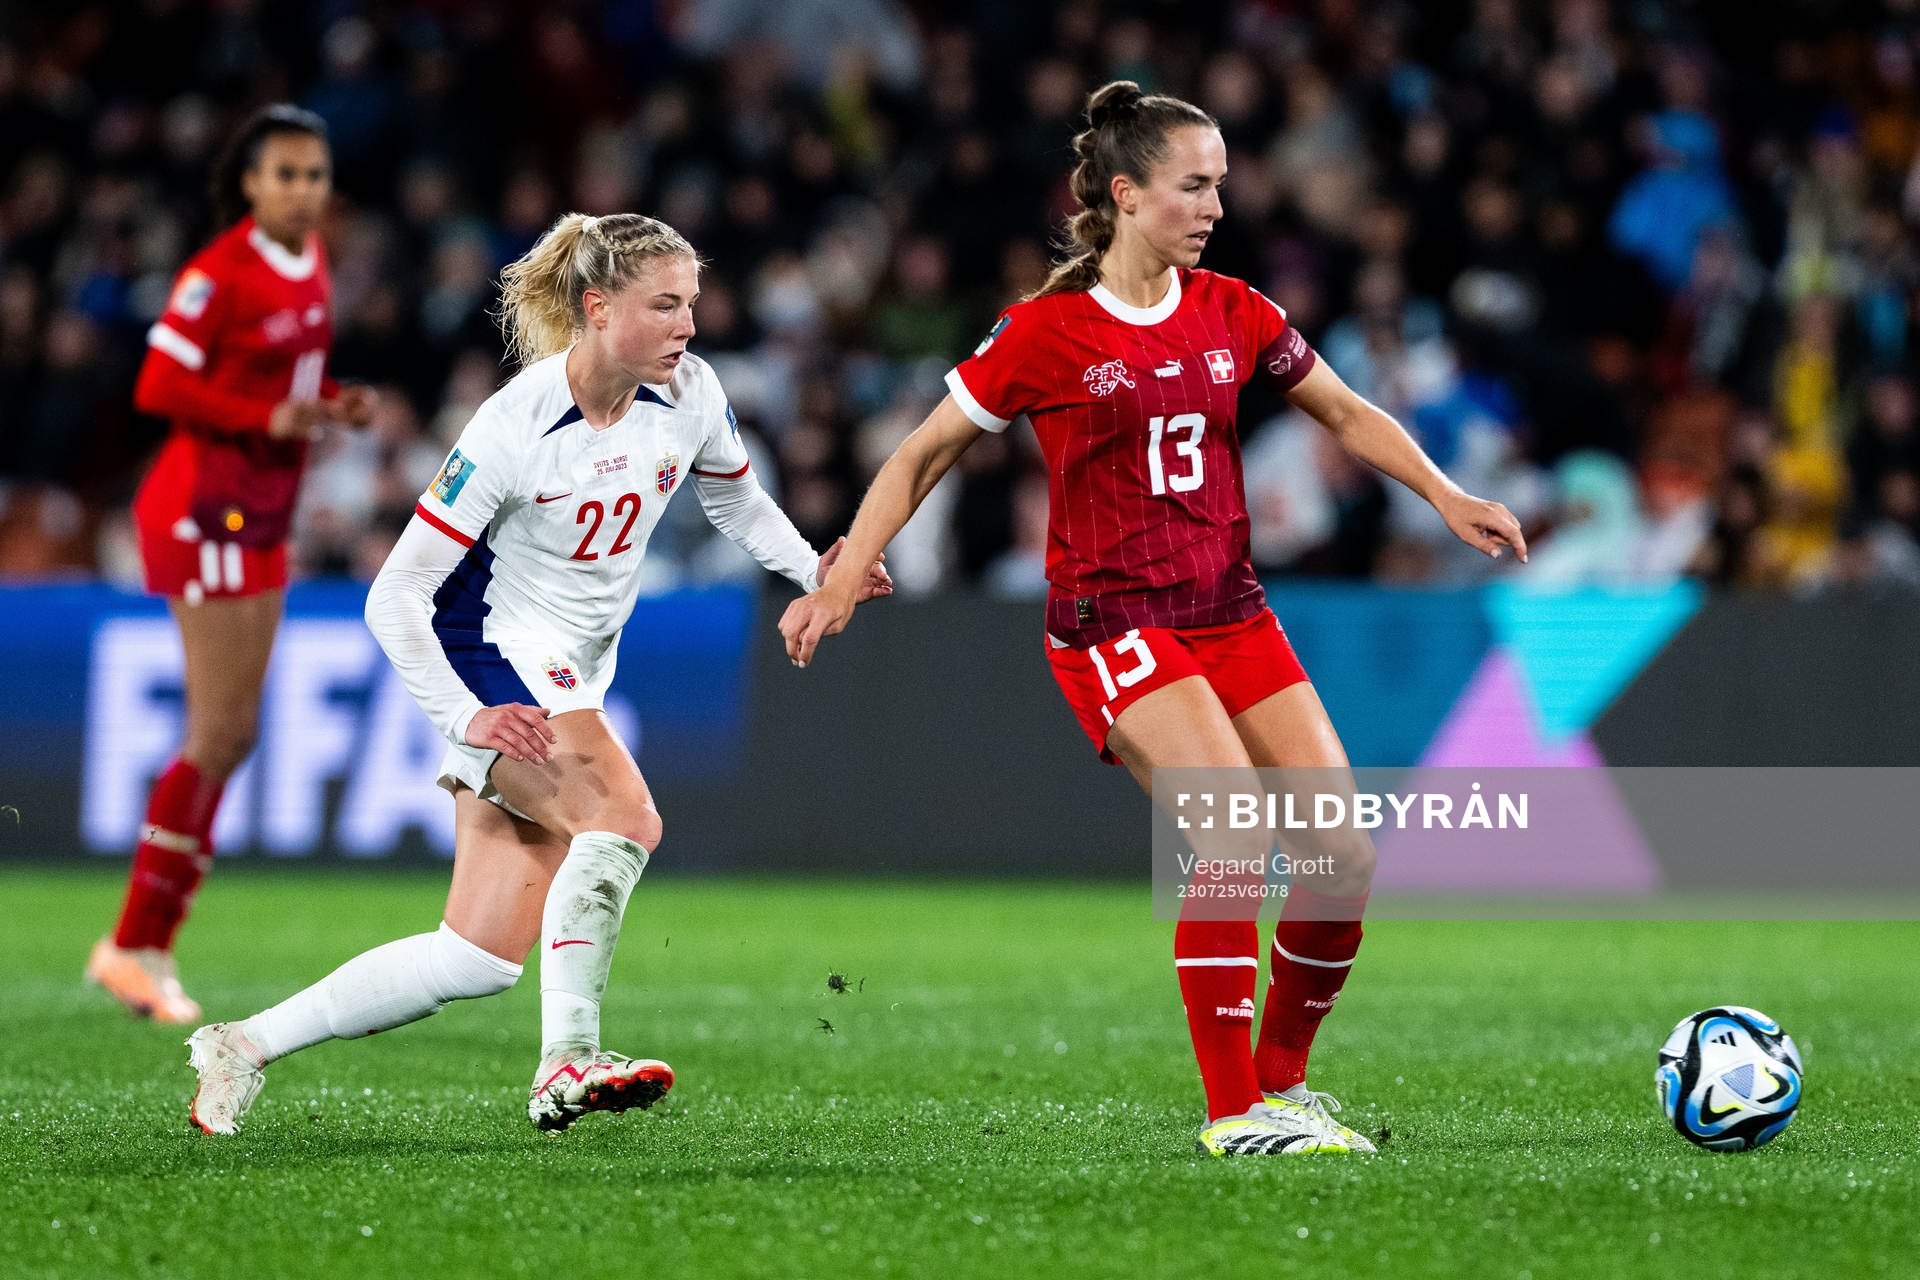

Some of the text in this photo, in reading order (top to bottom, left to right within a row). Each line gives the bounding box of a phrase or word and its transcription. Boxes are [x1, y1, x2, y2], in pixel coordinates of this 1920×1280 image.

[1147, 412, 1207, 496] 13
[569, 492, 642, 561] 22
[202, 540, 245, 593] 11
[1088, 628, 1157, 702] 13
[1216, 1007, 1254, 1018] PUM
